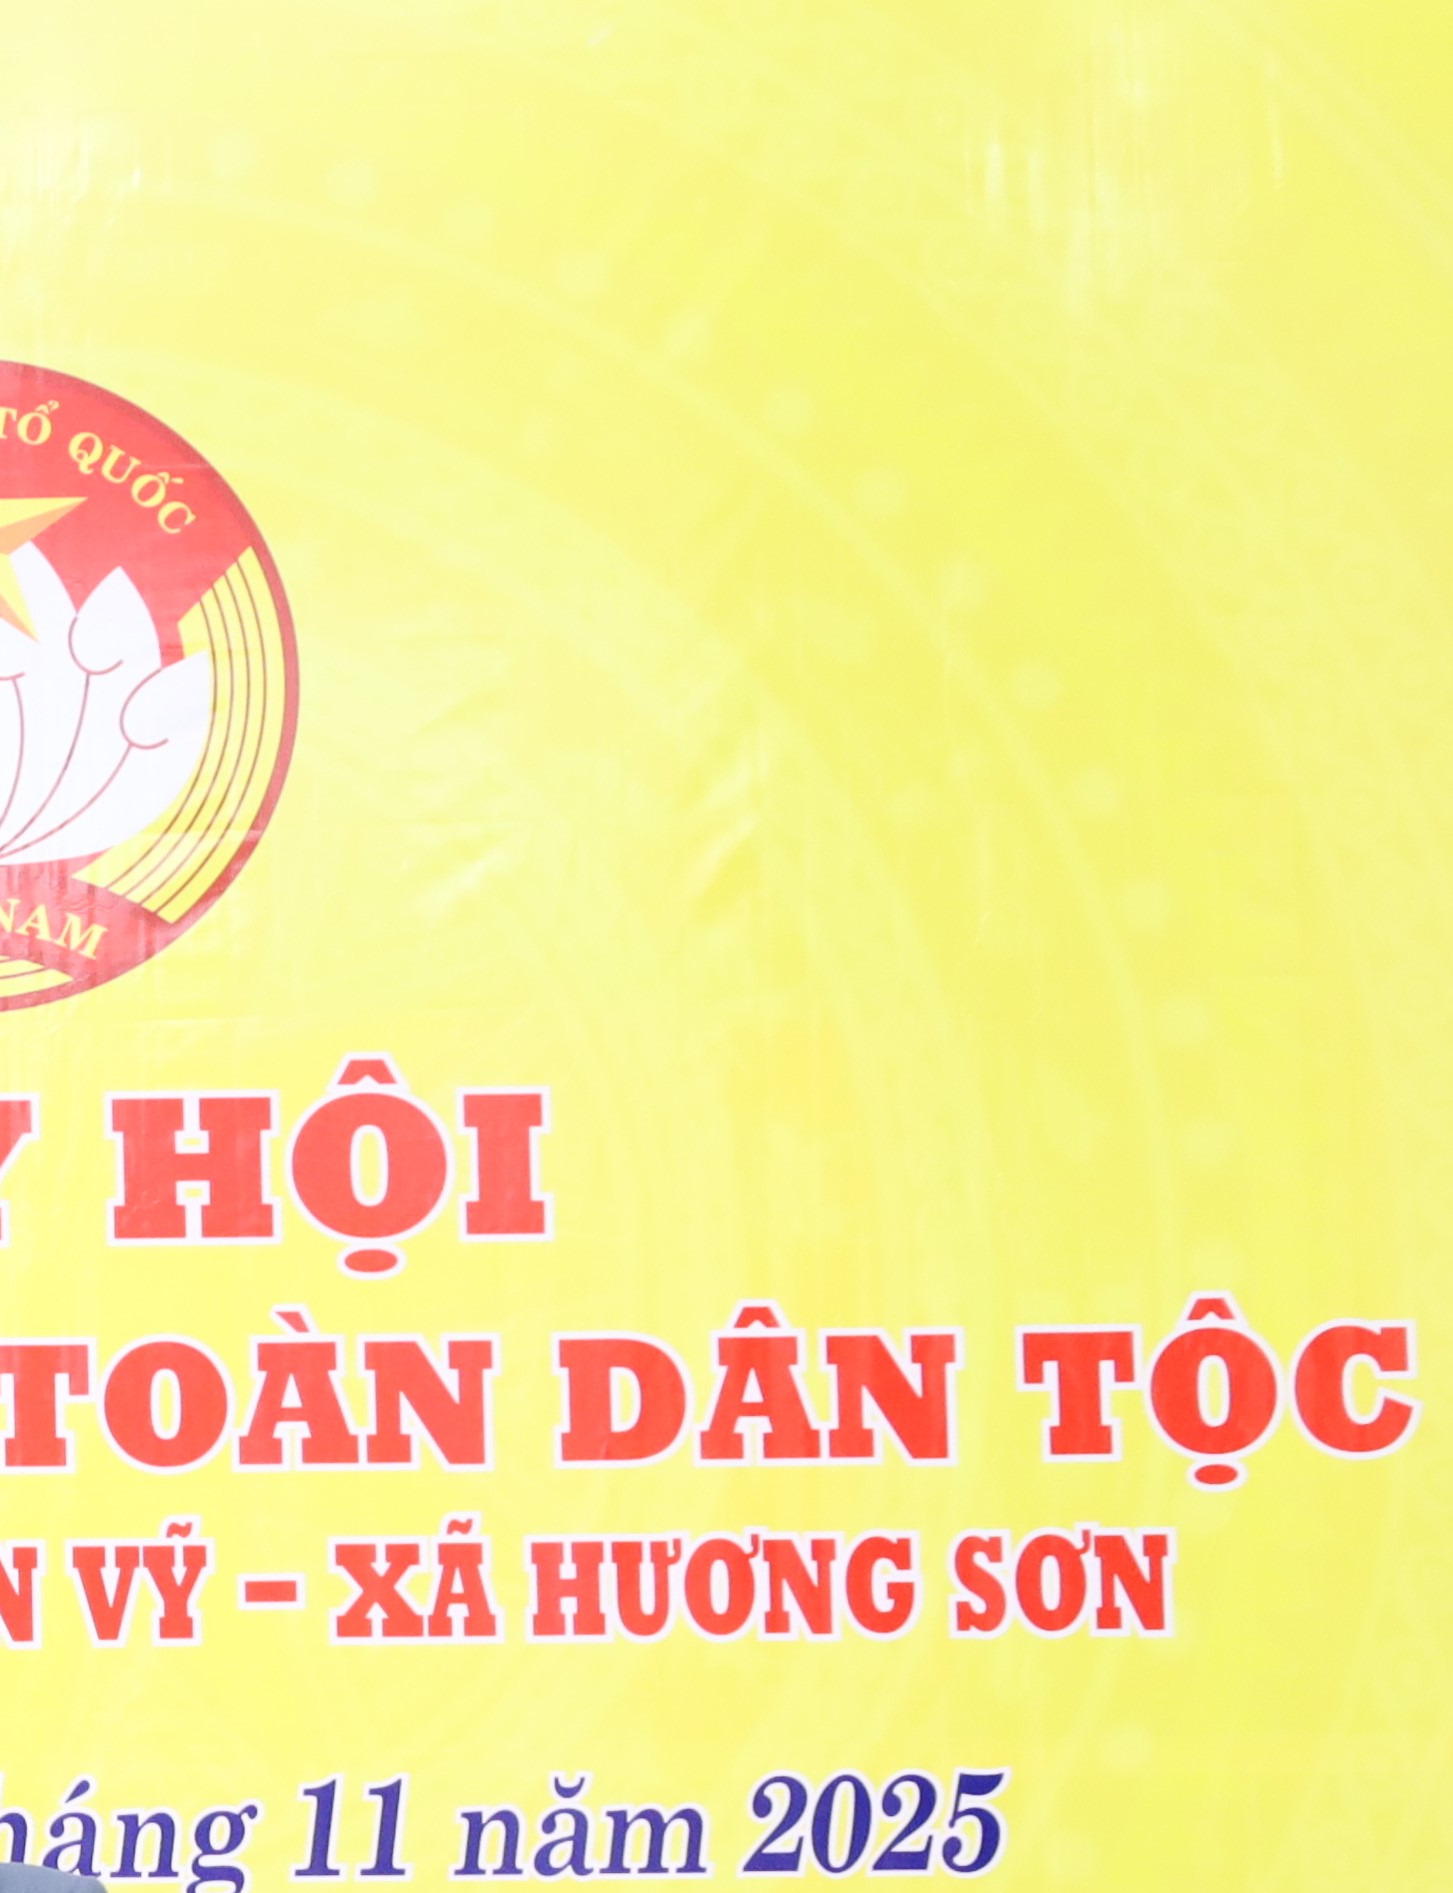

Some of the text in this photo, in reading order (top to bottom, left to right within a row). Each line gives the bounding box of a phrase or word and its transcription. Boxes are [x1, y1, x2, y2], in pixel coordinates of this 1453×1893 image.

[68, 431, 197, 535] QUỐC
[112, 1058, 546, 1272] HỘI
[558, 1305, 957, 1462] DÂN
[1022, 1297, 1415, 1487] TỘC
[73, 1521, 207, 1641] VỸ
[244, 1580, 298, 1603] -
[334, 1519, 497, 1639] XÃ
[530, 1533, 916, 1637] HƯƠNG
[953, 1528, 1170, 1634] SƠN
[294, 1779, 406, 1878] 11
[454, 1777, 707, 1878] năm
[743, 1772, 1005, 1876] 2025
